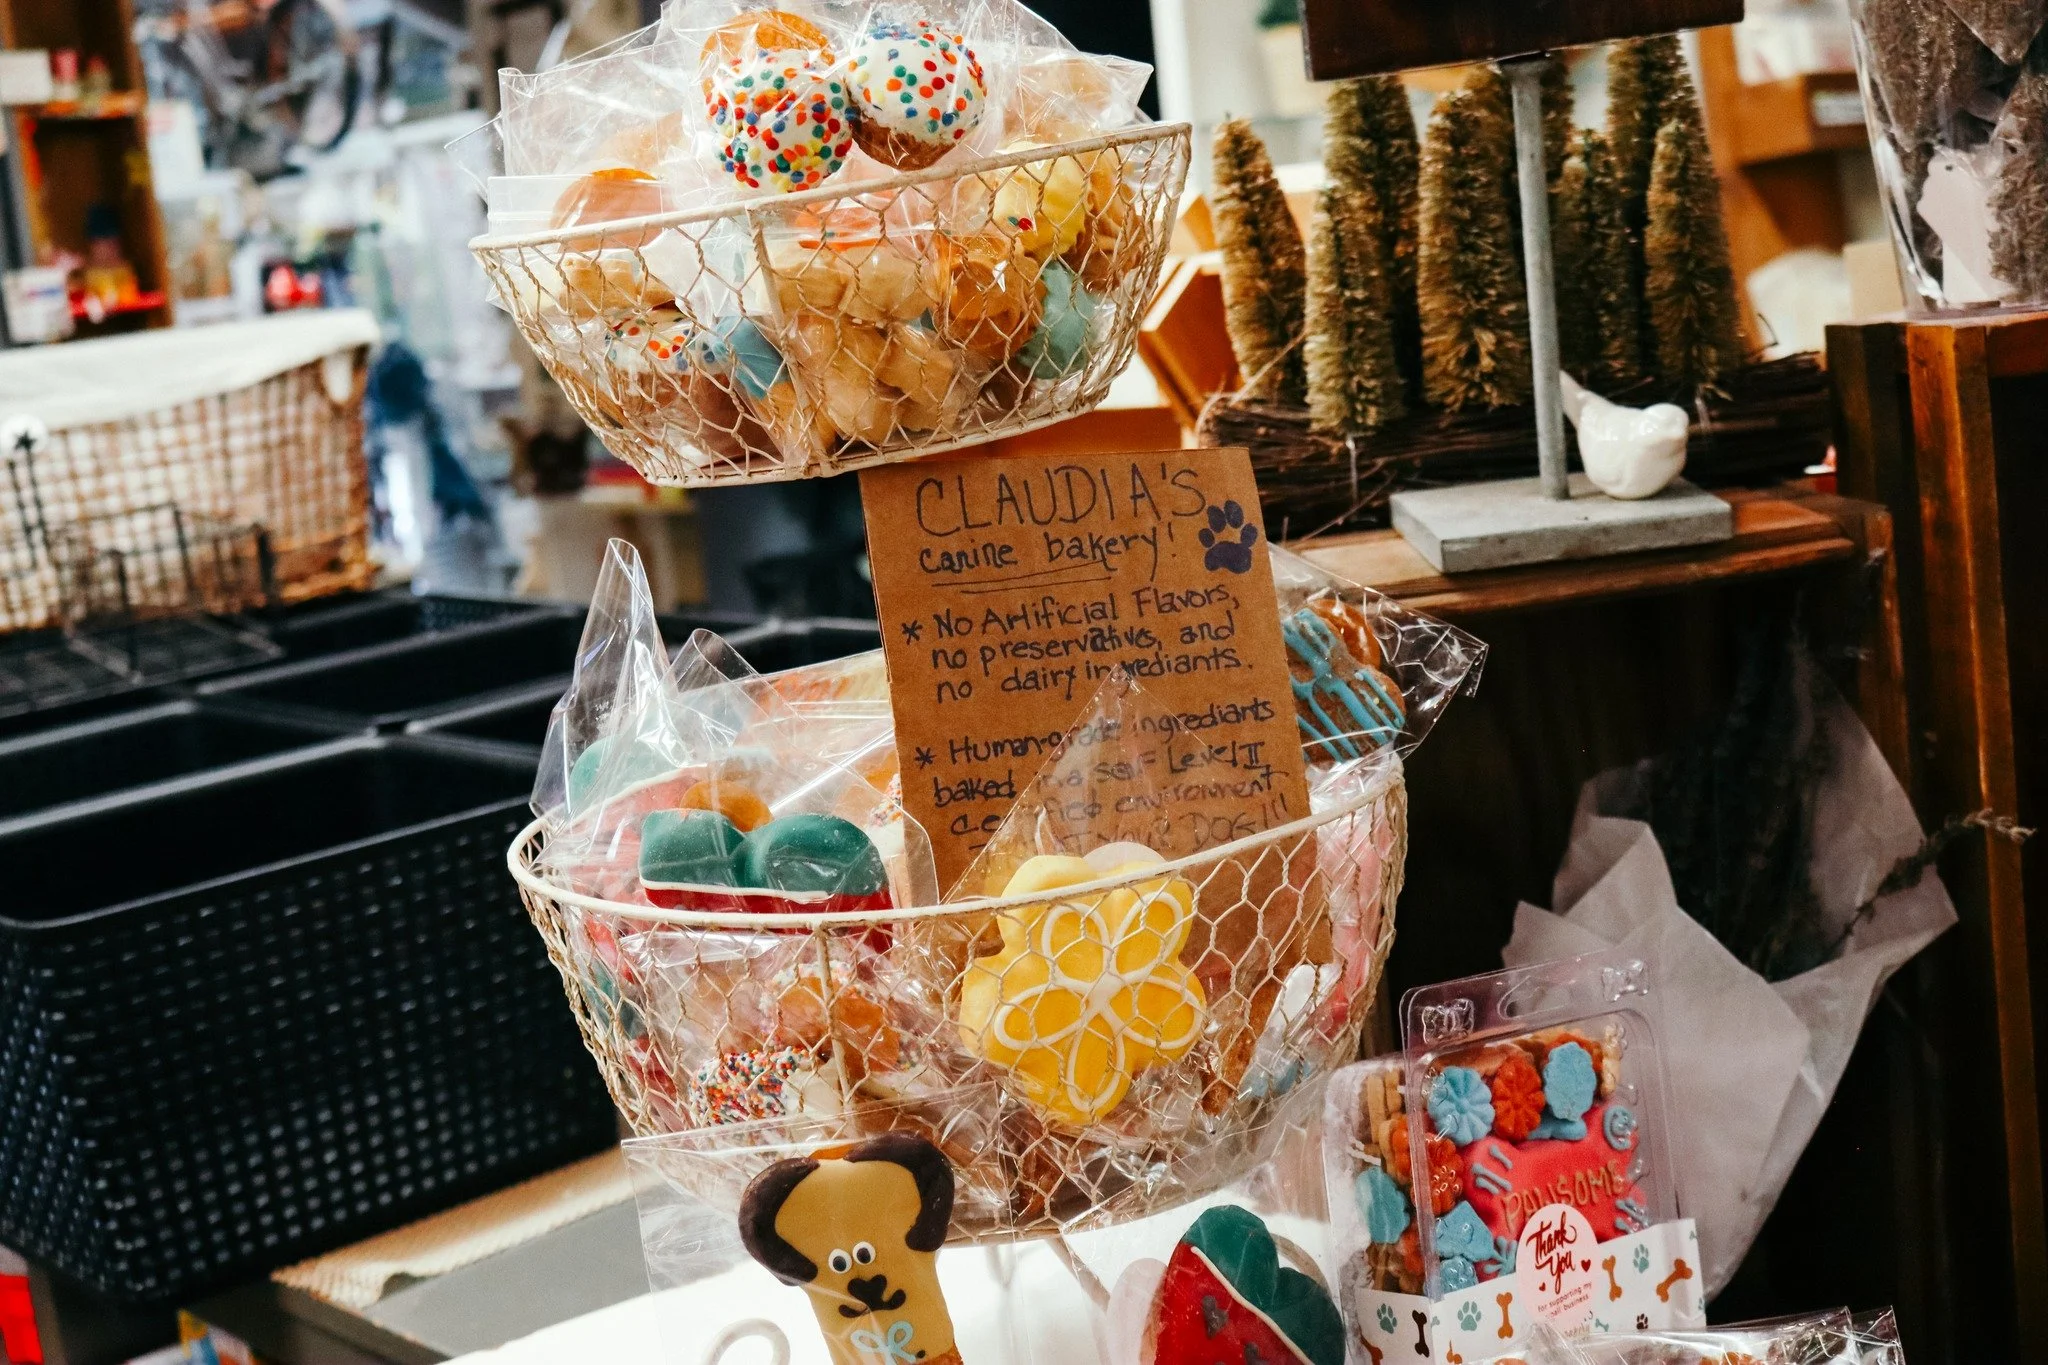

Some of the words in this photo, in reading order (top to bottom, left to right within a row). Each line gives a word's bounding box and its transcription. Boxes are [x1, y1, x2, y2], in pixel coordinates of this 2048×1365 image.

[916, 462, 1207, 537] CLAUDIA'S
[919, 538, 1018, 574] canine
[1043, 521, 1177, 582] bakery!
[933, 608, 973, 638] No
[981, 592, 1119, 635] Artificial
[1131, 584, 1240, 618] Flavors,
[932, 648, 967, 669] no
[1180, 610, 1235, 644] and
[937, 680, 972, 704] no
[1001, 666, 1076, 700] dairy
[1132, 697, 1275, 743] ingrediants
[934, 769, 1017, 807] baked
[1168, 741, 1237, 773] Level
[1501, 1160, 1625, 1236] PAWSOME
[1526, 1211, 1577, 1265] Thank
[1535, 1251, 1576, 1294] You
[1549, 1287, 1582, 1307] supporting
